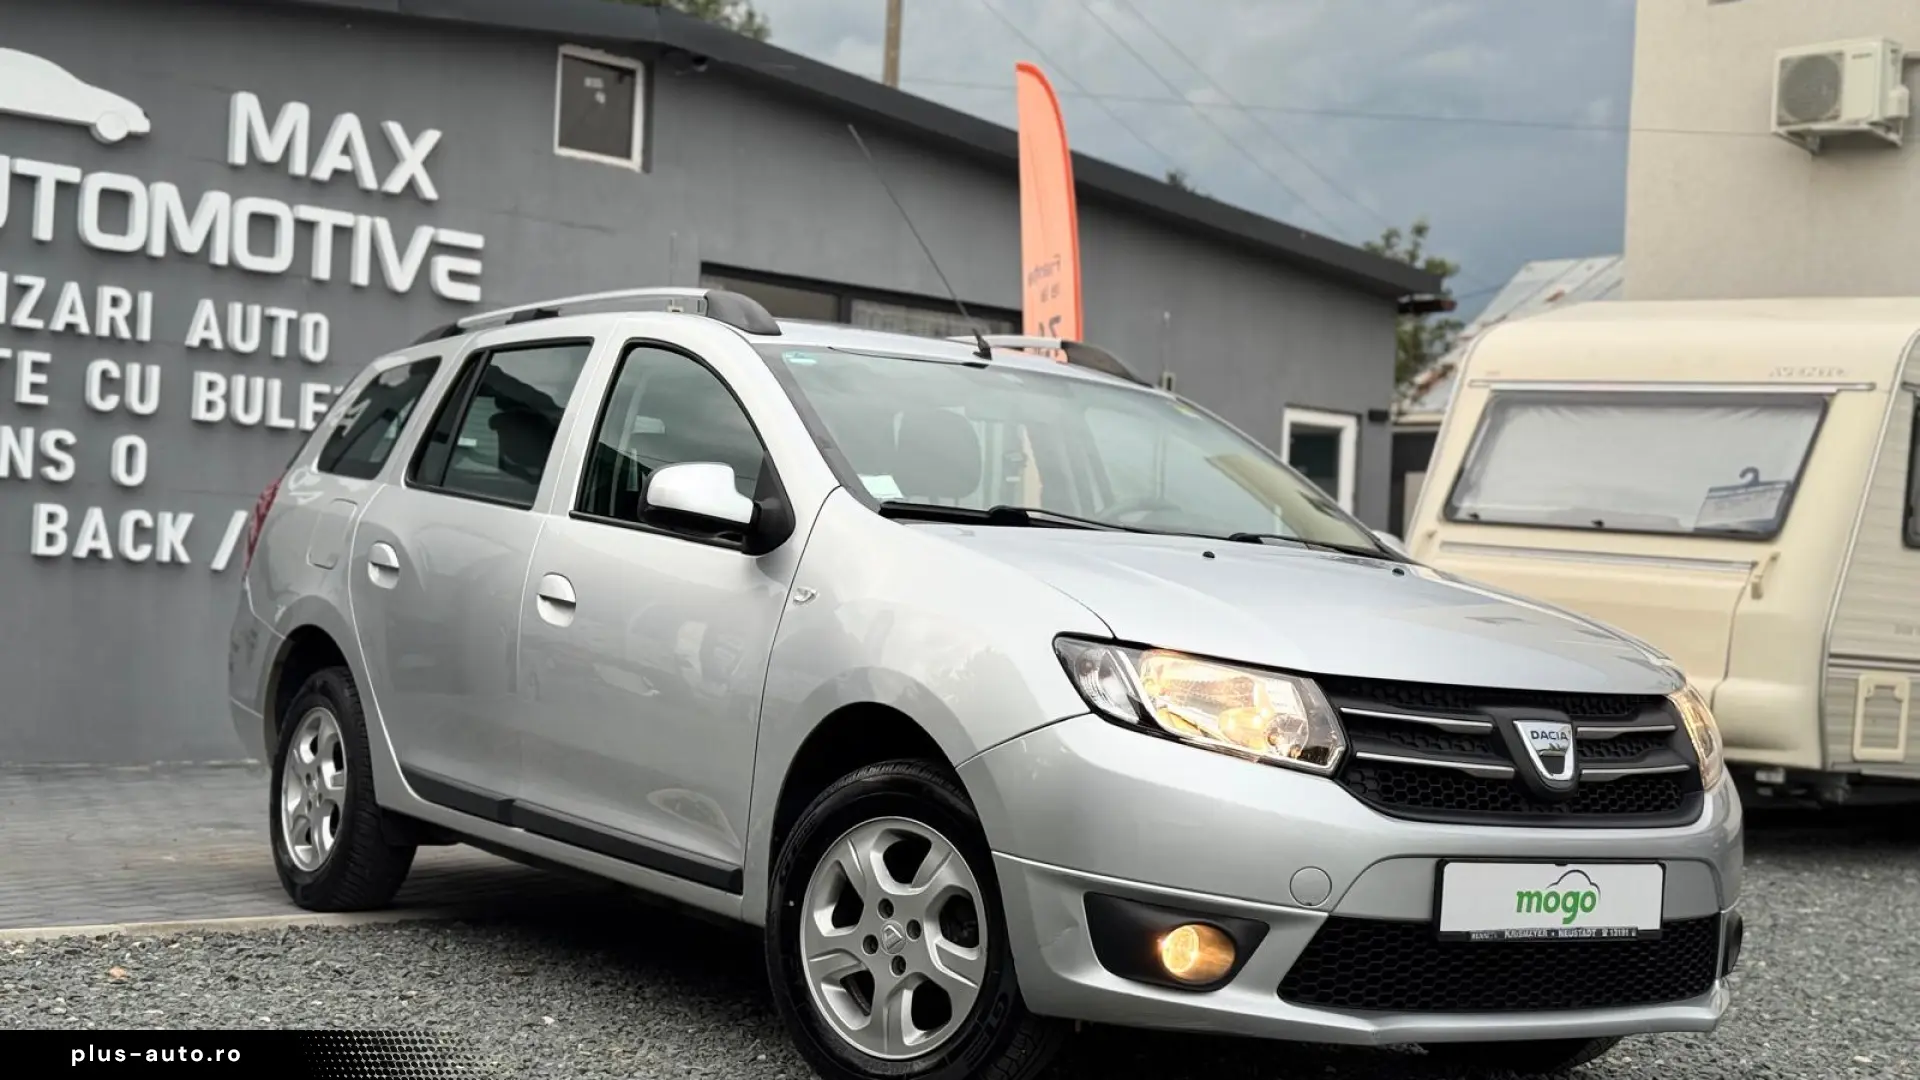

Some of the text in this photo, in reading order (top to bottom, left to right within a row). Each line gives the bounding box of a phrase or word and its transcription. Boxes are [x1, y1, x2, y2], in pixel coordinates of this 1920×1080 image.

[228, 91, 442, 200] MAX
[0, 154, 485, 301] TOMOTIVE
[185, 298, 330, 363] AUTO
[86, 358, 161, 415] CU
[192, 370, 345, 432] BULE
[111, 434, 147, 486] O
[31, 502, 195, 564] BACK
[1530, 730, 1569, 741] DACIA
[1516, 889, 1597, 924] mogo
